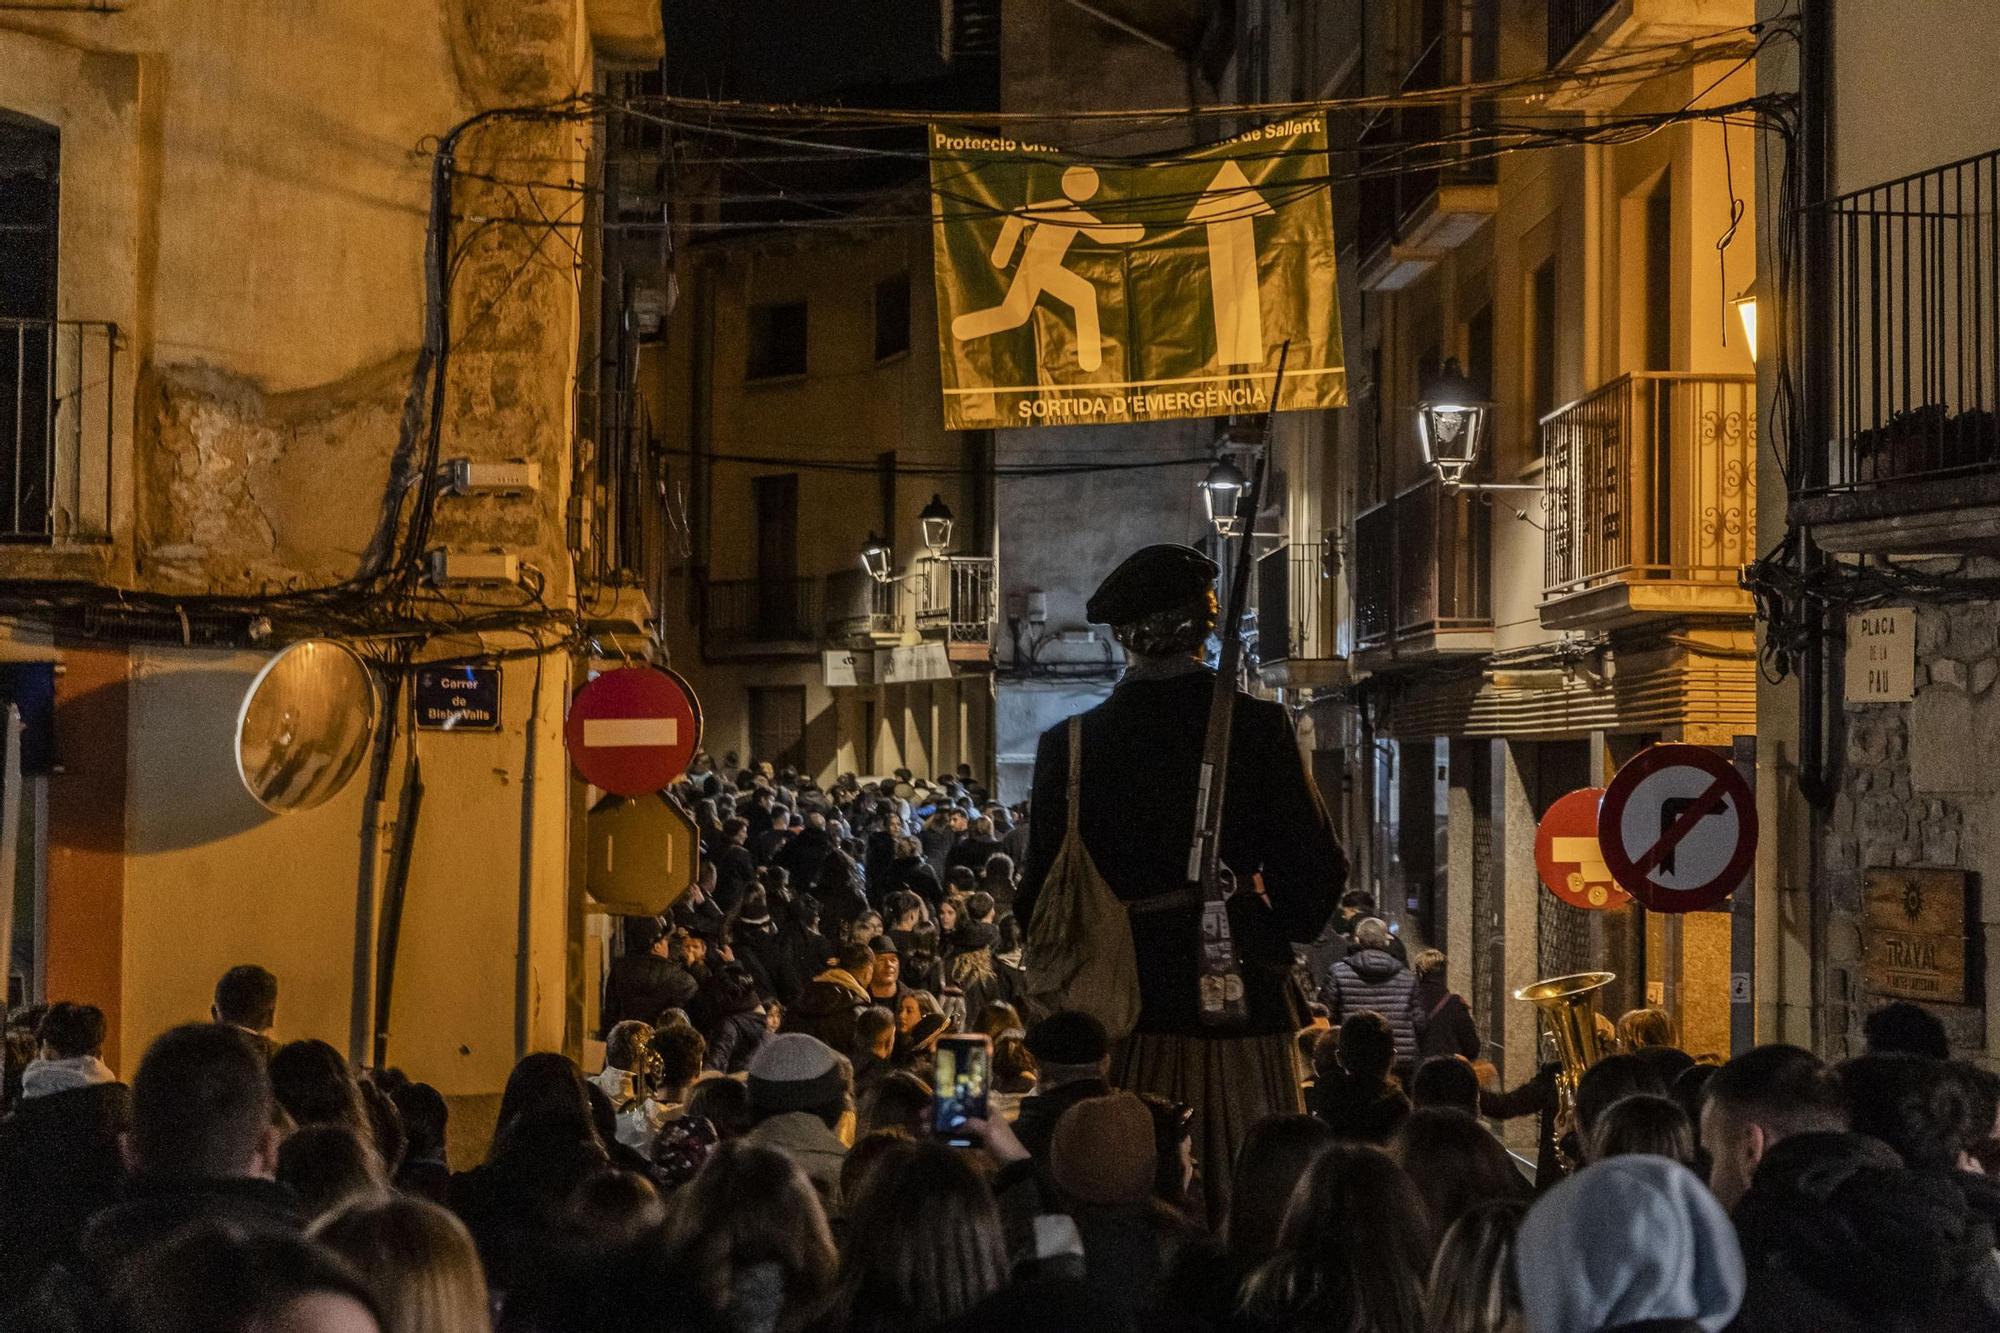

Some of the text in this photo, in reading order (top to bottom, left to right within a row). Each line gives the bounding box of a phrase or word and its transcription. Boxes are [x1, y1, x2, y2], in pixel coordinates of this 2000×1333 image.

[1264, 118, 1321, 139] Sallent
[1018, 387, 1267, 418] SORTIDA D'EMERGÈNCIA
[1869, 645, 1887, 661] DE LA
[440, 678, 479, 689] Carrer
[1868, 670, 1889, 694] PAU
[451, 696, 467, 706] de
